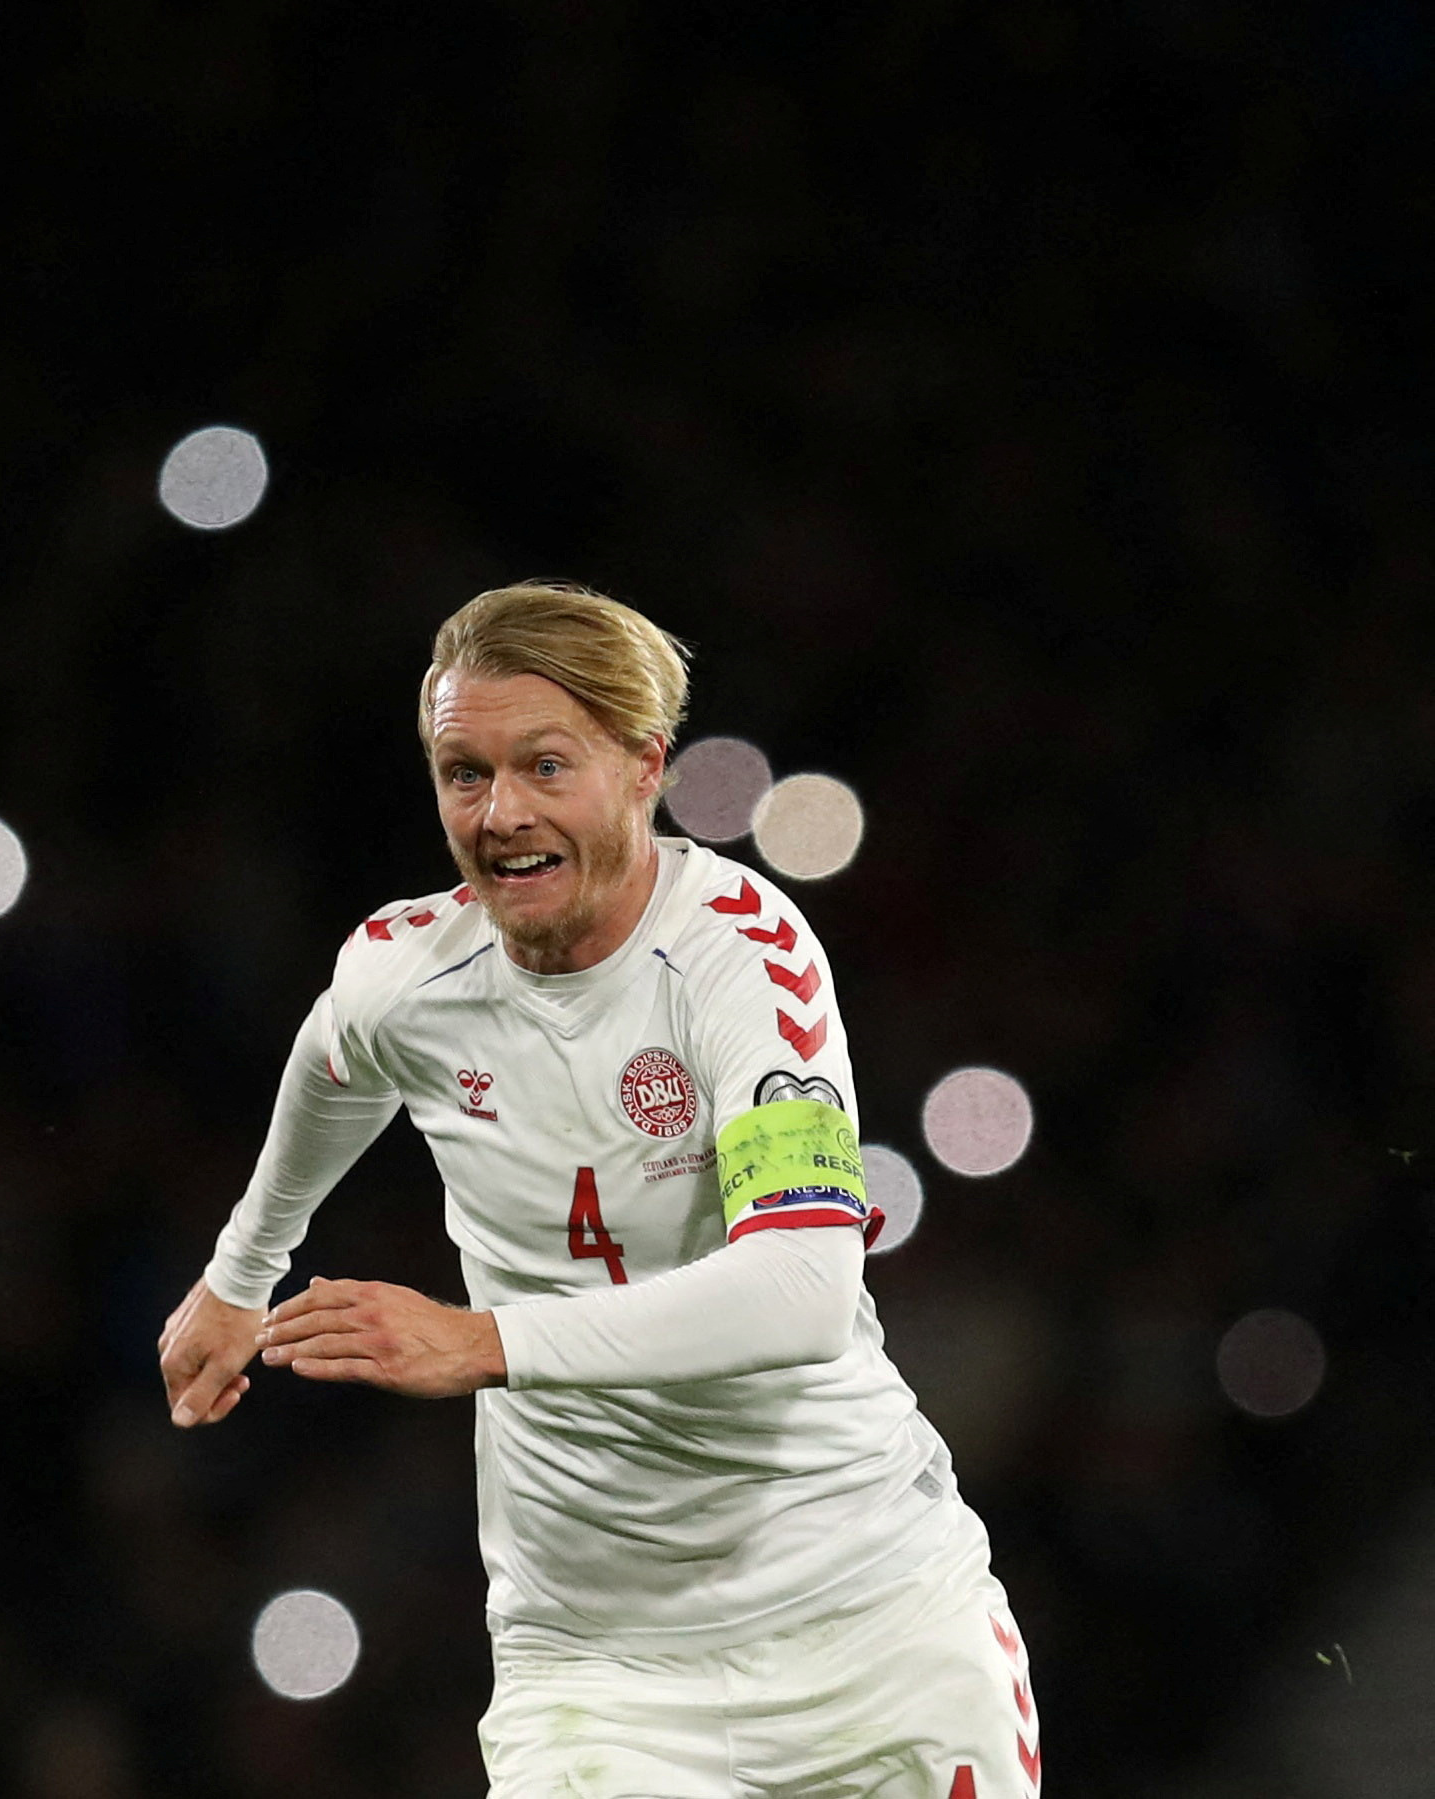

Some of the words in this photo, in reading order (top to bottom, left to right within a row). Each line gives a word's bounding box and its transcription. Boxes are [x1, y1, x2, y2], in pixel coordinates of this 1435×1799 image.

[622, 1083, 652, 1132] DANSK
[636, 1077, 684, 1110] DBU
[657, 1122, 689, 1137] 1889
[642, 1156, 679, 1173] SCOTLAND
[722, 1164, 756, 1199] ECT
[568, 1167, 628, 1285] 4
